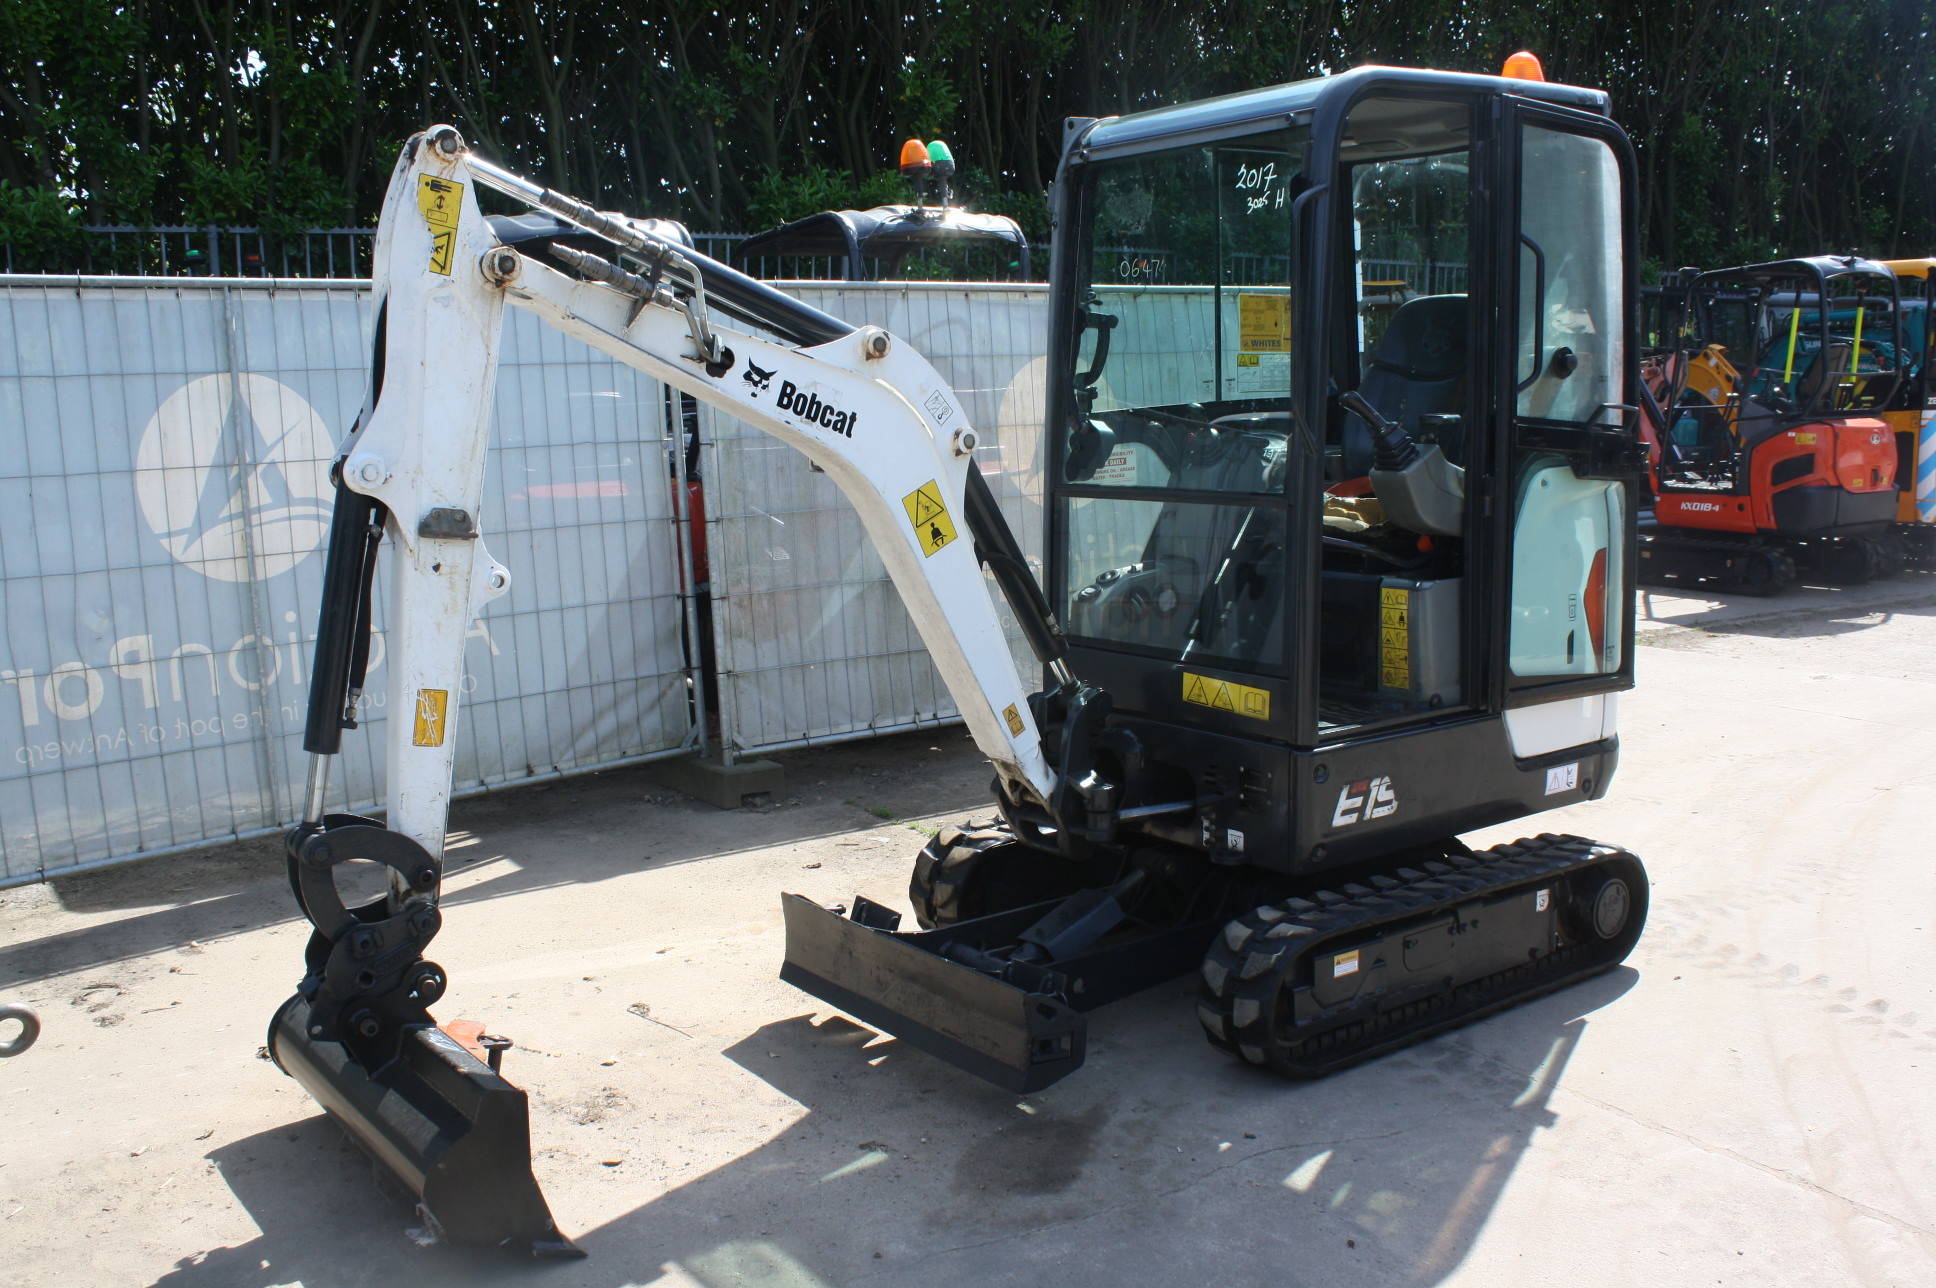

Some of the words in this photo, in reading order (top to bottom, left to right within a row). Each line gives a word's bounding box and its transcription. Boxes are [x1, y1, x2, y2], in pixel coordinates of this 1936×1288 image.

[1235, 163, 1277, 191] 2017
[1274, 187, 1285, 209] H
[776, 379, 858, 439] Bobcat
